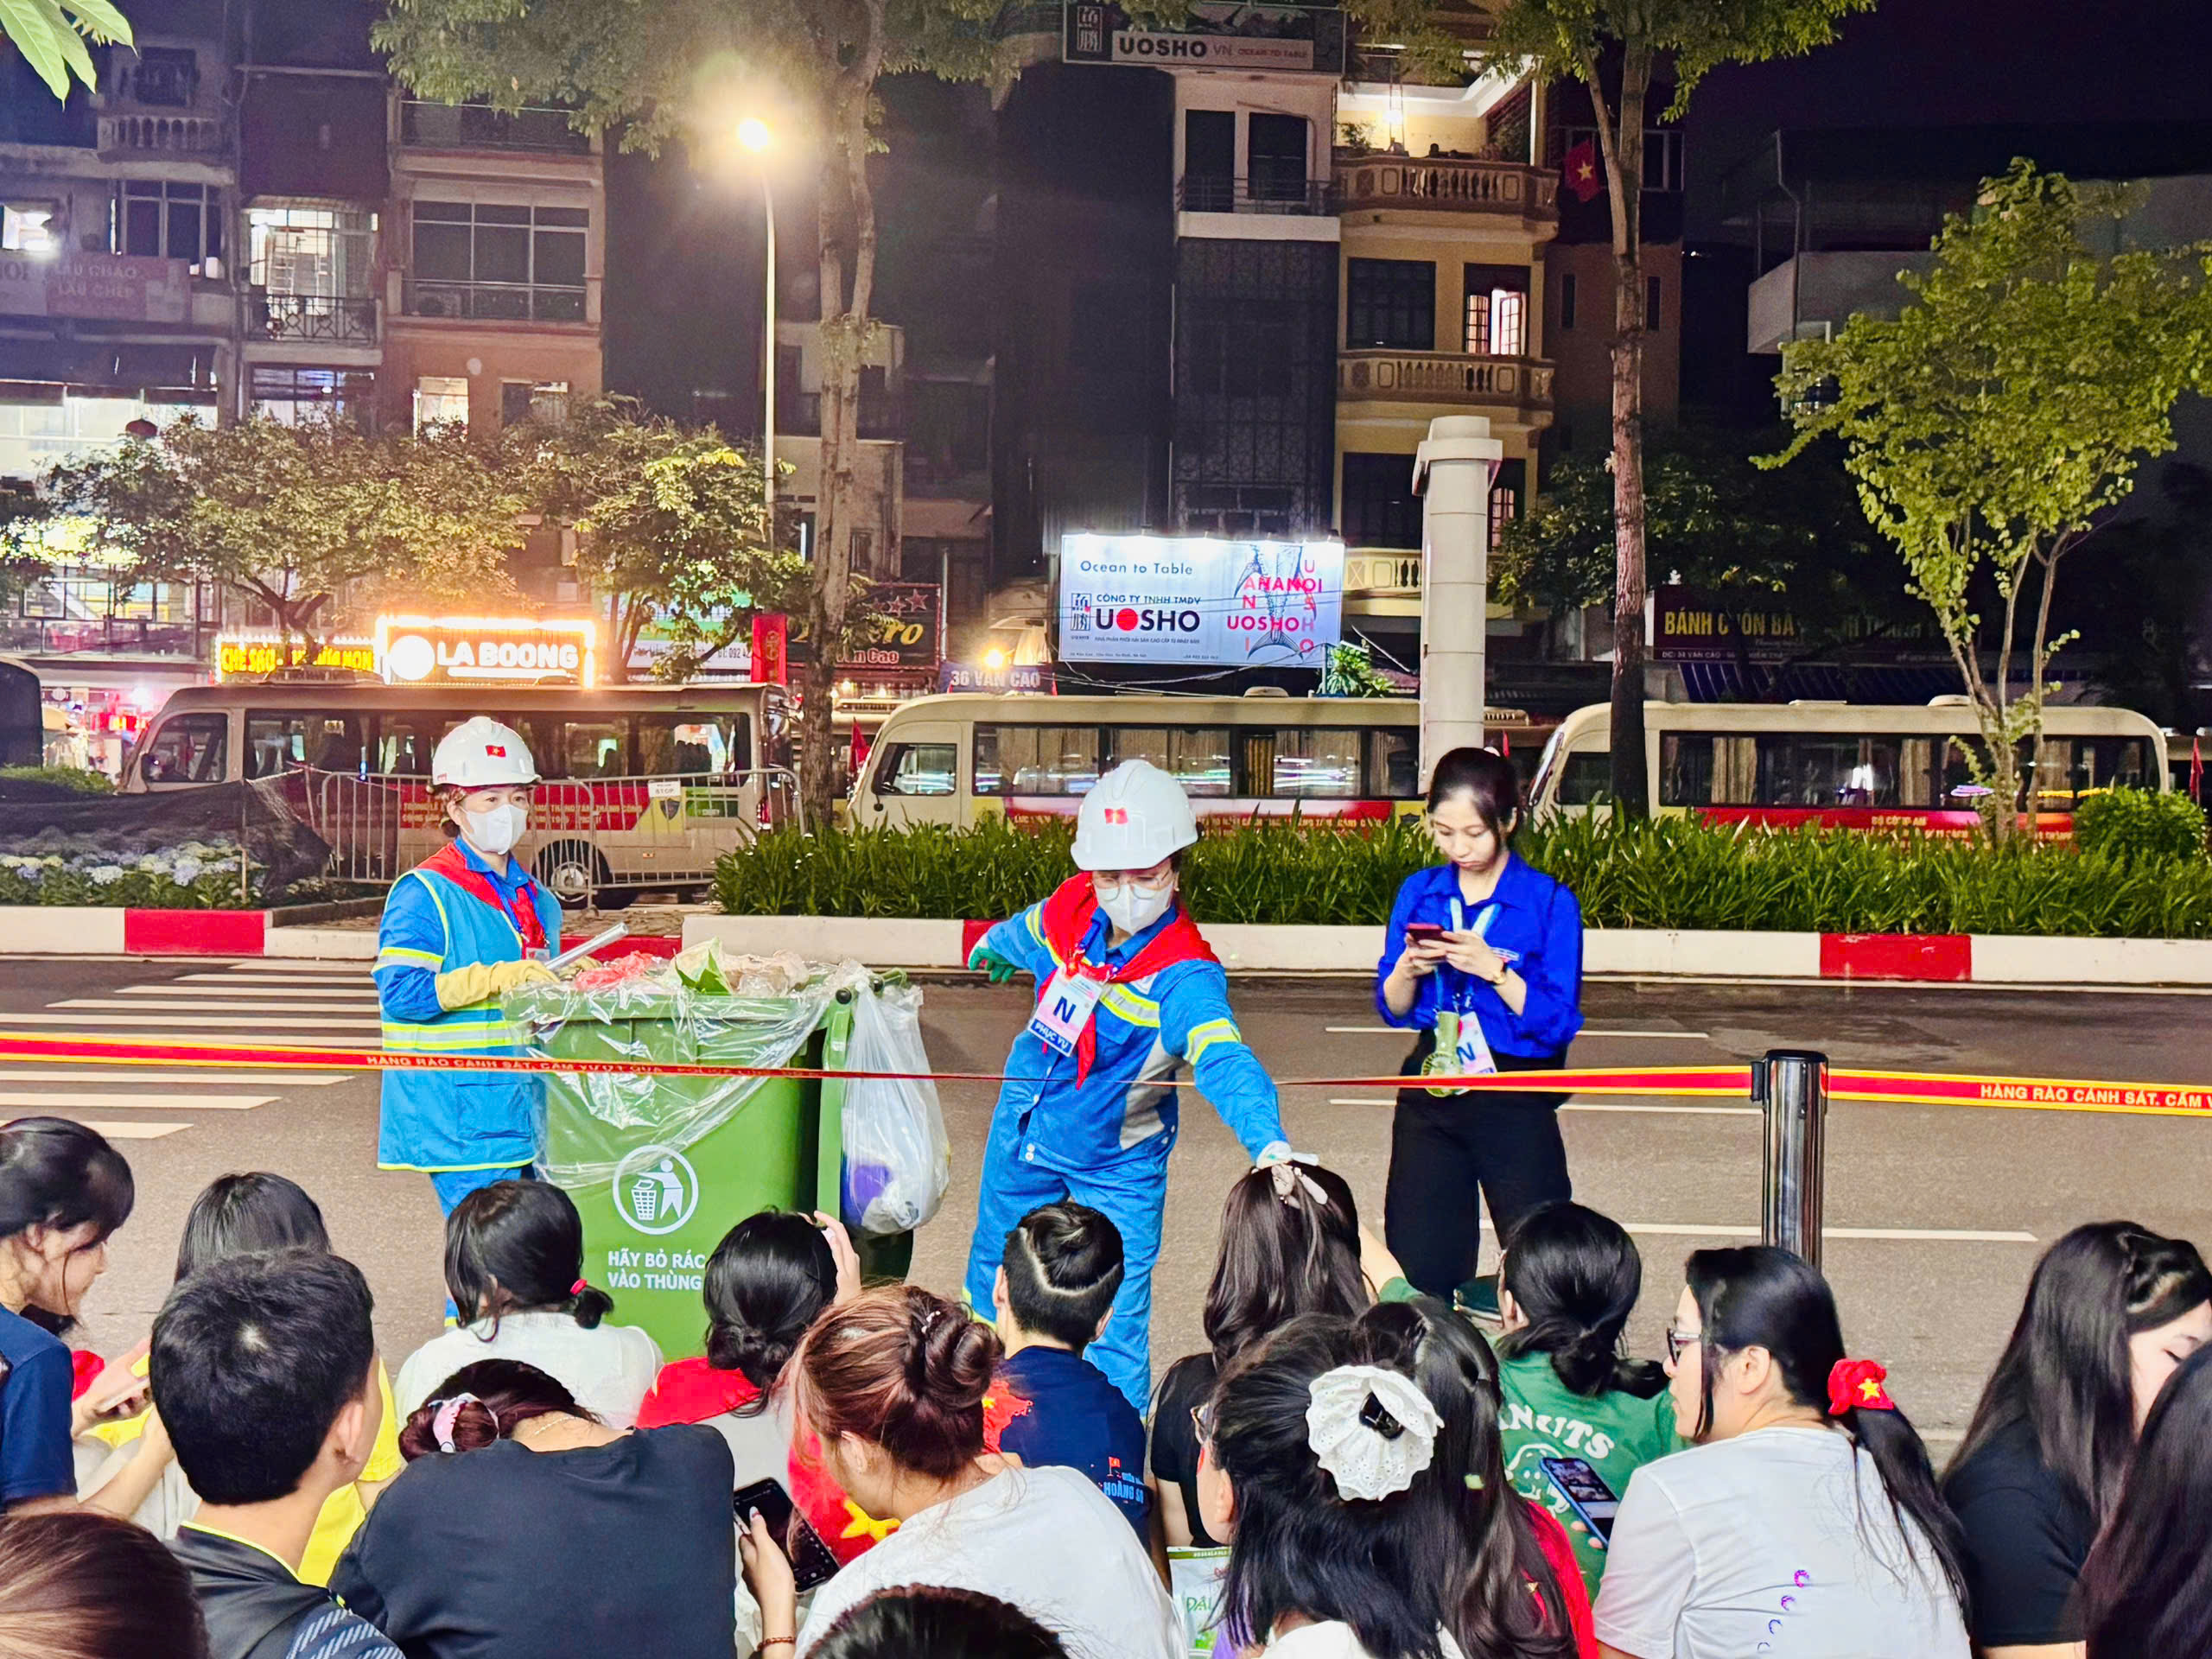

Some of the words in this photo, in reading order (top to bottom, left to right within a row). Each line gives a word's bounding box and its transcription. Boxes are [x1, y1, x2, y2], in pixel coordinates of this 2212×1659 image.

[1119, 36, 1208, 58] UOSHO
[1080, 560, 1127, 574] Ocean
[1134, 562, 1147, 574] to
[1154, 563, 1193, 575] Table
[1129, 594, 1141, 604] TY
[1144, 595, 1172, 605] TNHH
[1174, 596, 1201, 605] TMDV
[1096, 607, 1201, 632] UOSHO
[1664, 607, 1713, 636] BÁNH
[437, 641, 475, 667] LA
[479, 641, 579, 670] BOONG
[867, 647, 899, 664] Cao
[1010, 671, 1041, 688] CAO
[1052, 995, 1077, 1024] N
[1456, 1041, 1477, 1065] N
[1980, 1083, 2028, 1101] HÀNG
[2032, 1084, 2069, 1103] RÀO
[2073, 1086, 2120, 1104] CẢNH
[2124, 1090, 2160, 1107] SÁT.
[2164, 1091, 2202, 1109] CẤM
[607, 1248, 640, 1268] HÃY
[645, 1248, 669, 1268] BỎ
[672, 1249, 706, 1269] RÁC
[607, 1268, 641, 1289] VÀO
[644, 1269, 702, 1291] THÙNG
